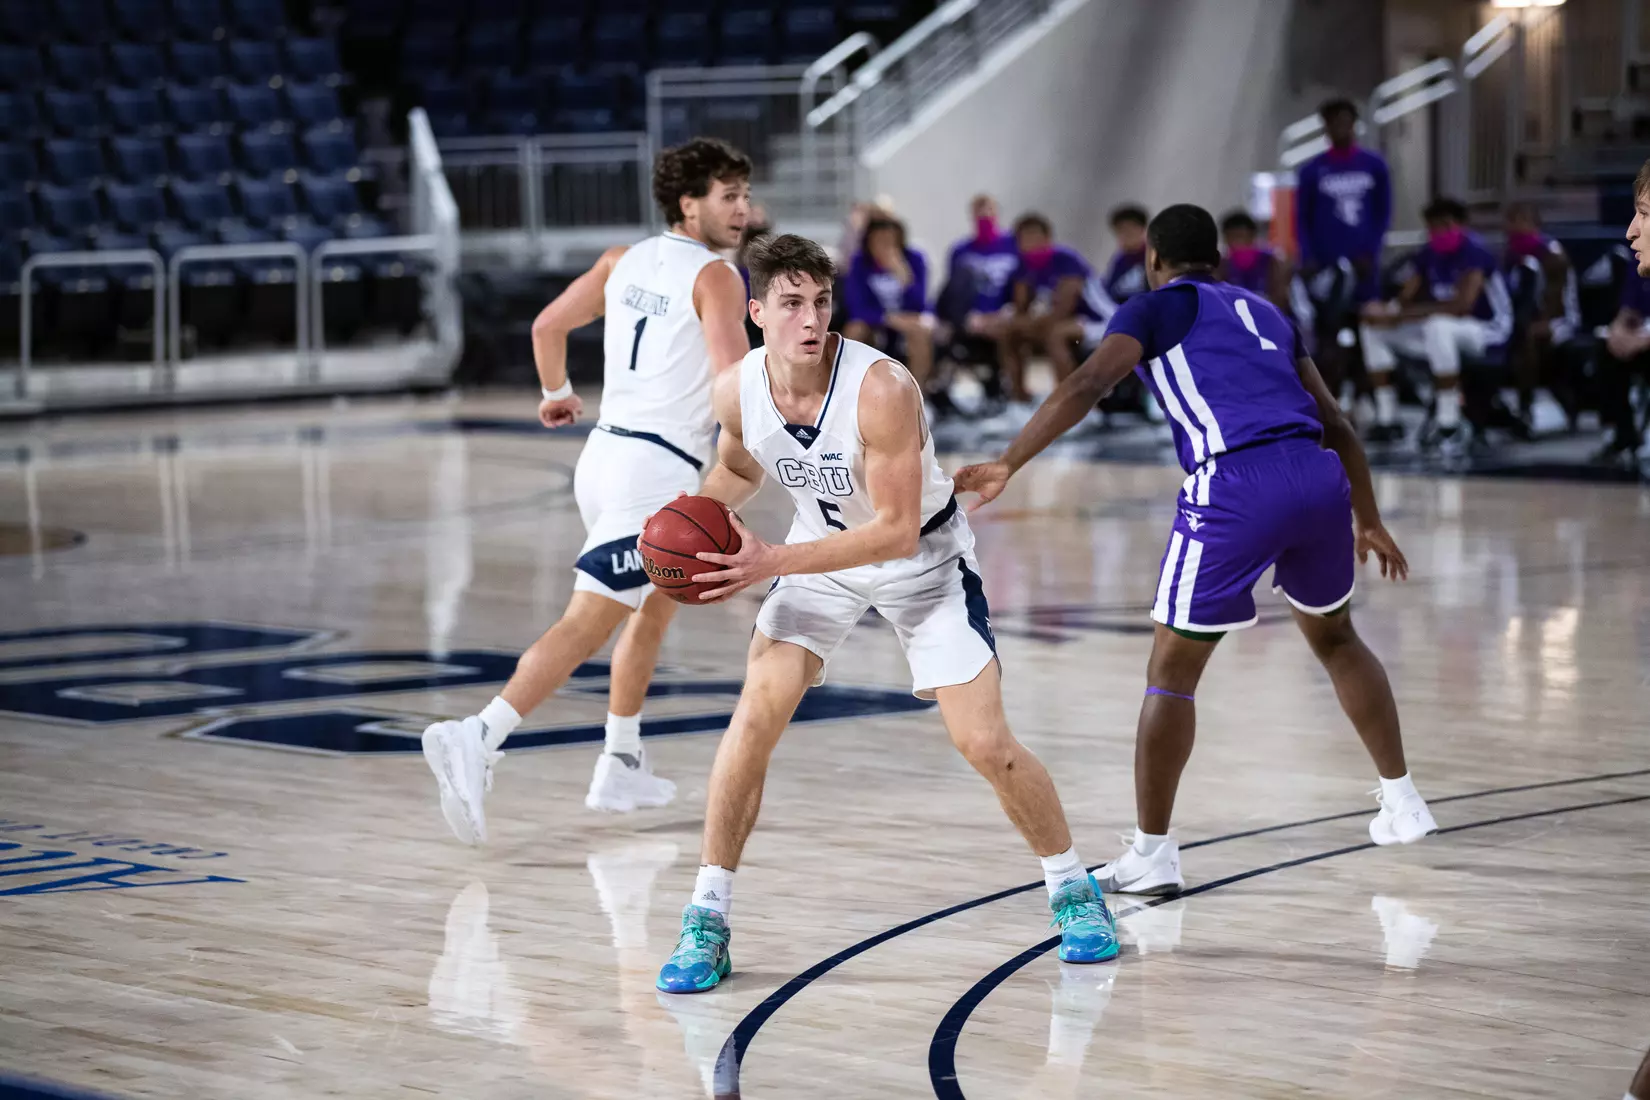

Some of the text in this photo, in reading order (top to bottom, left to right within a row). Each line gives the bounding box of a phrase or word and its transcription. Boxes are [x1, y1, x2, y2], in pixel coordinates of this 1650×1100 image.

[629, 316, 648, 371] 1
[1234, 298, 1278, 351] 1
[820, 453, 843, 461] WAC
[776, 458, 853, 496] CBU
[645, 556, 686, 579] ilson
